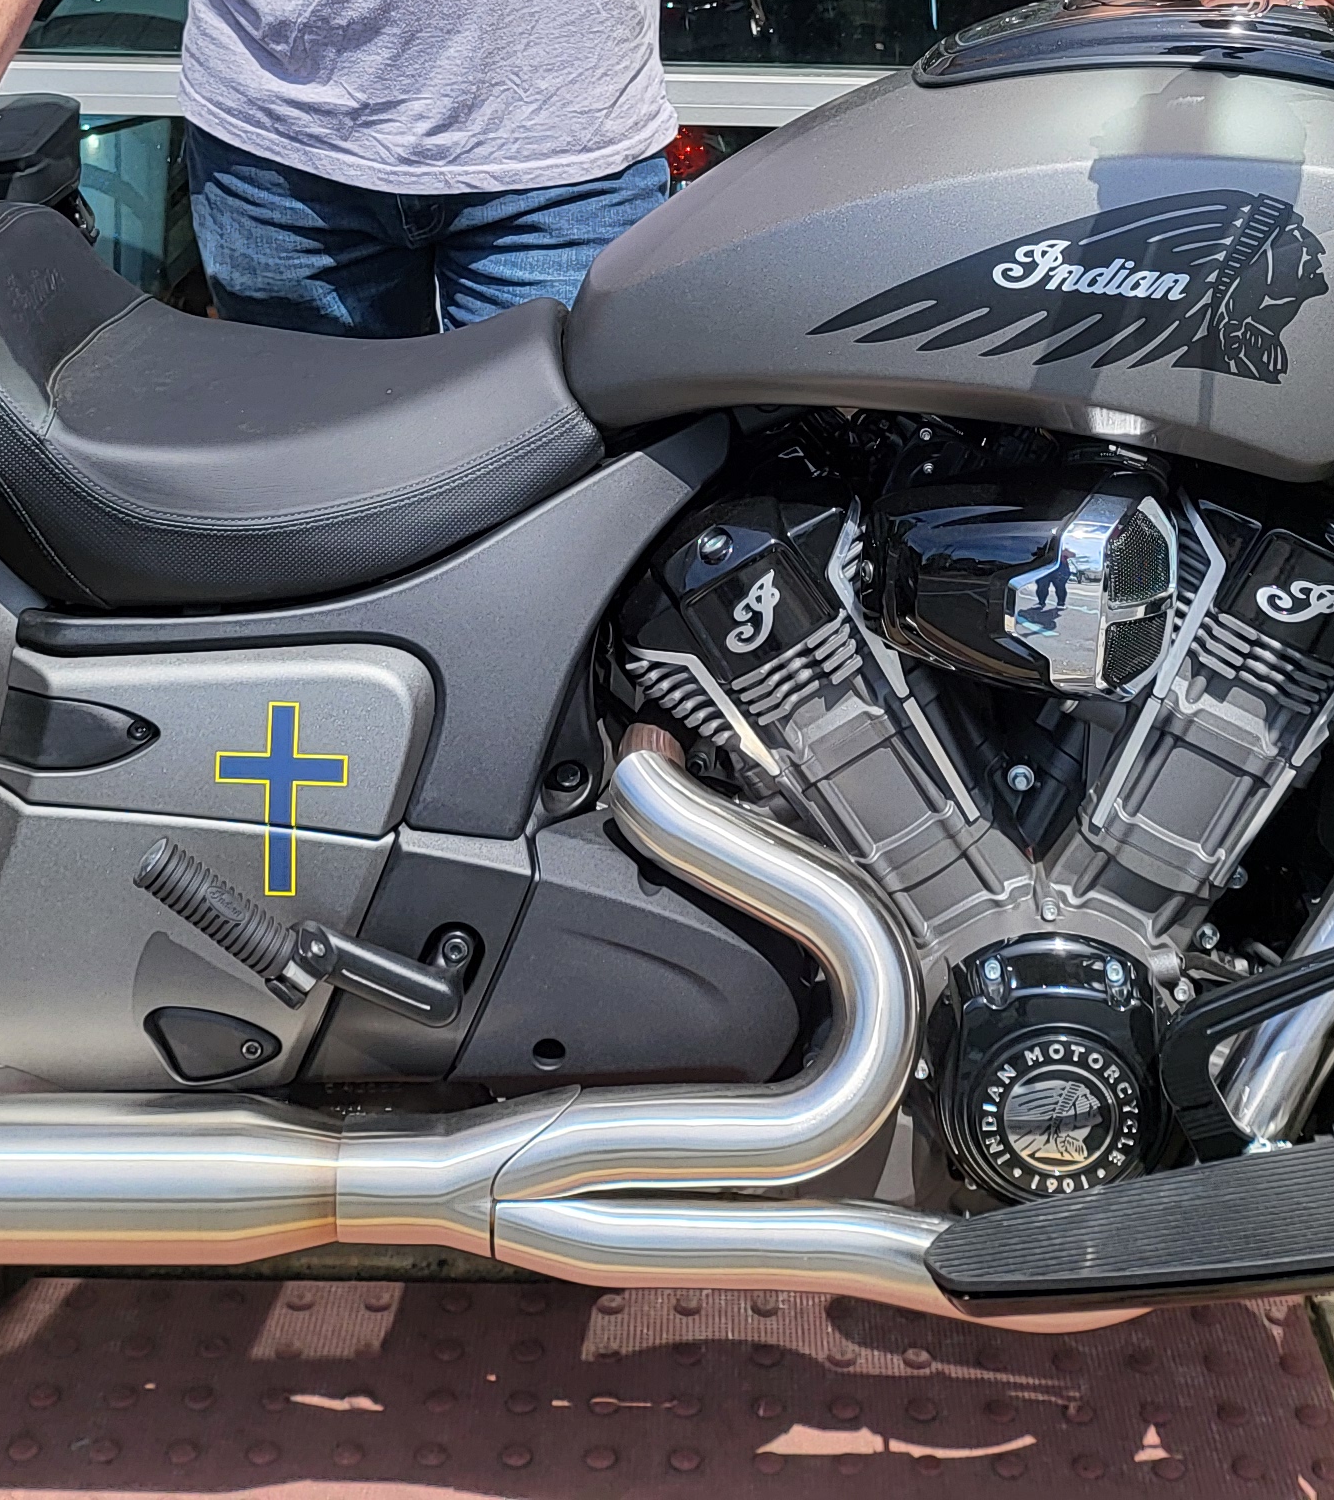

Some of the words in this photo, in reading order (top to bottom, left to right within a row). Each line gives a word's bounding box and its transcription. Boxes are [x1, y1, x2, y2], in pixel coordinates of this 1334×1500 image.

[992, 239, 1190, 301] Indian
[982, 1063, 1017, 1165] INDIAN
[1023, 1043, 1139, 1167] MOTORCYCLE
[1030, 1173, 1090, 1194] 1901
